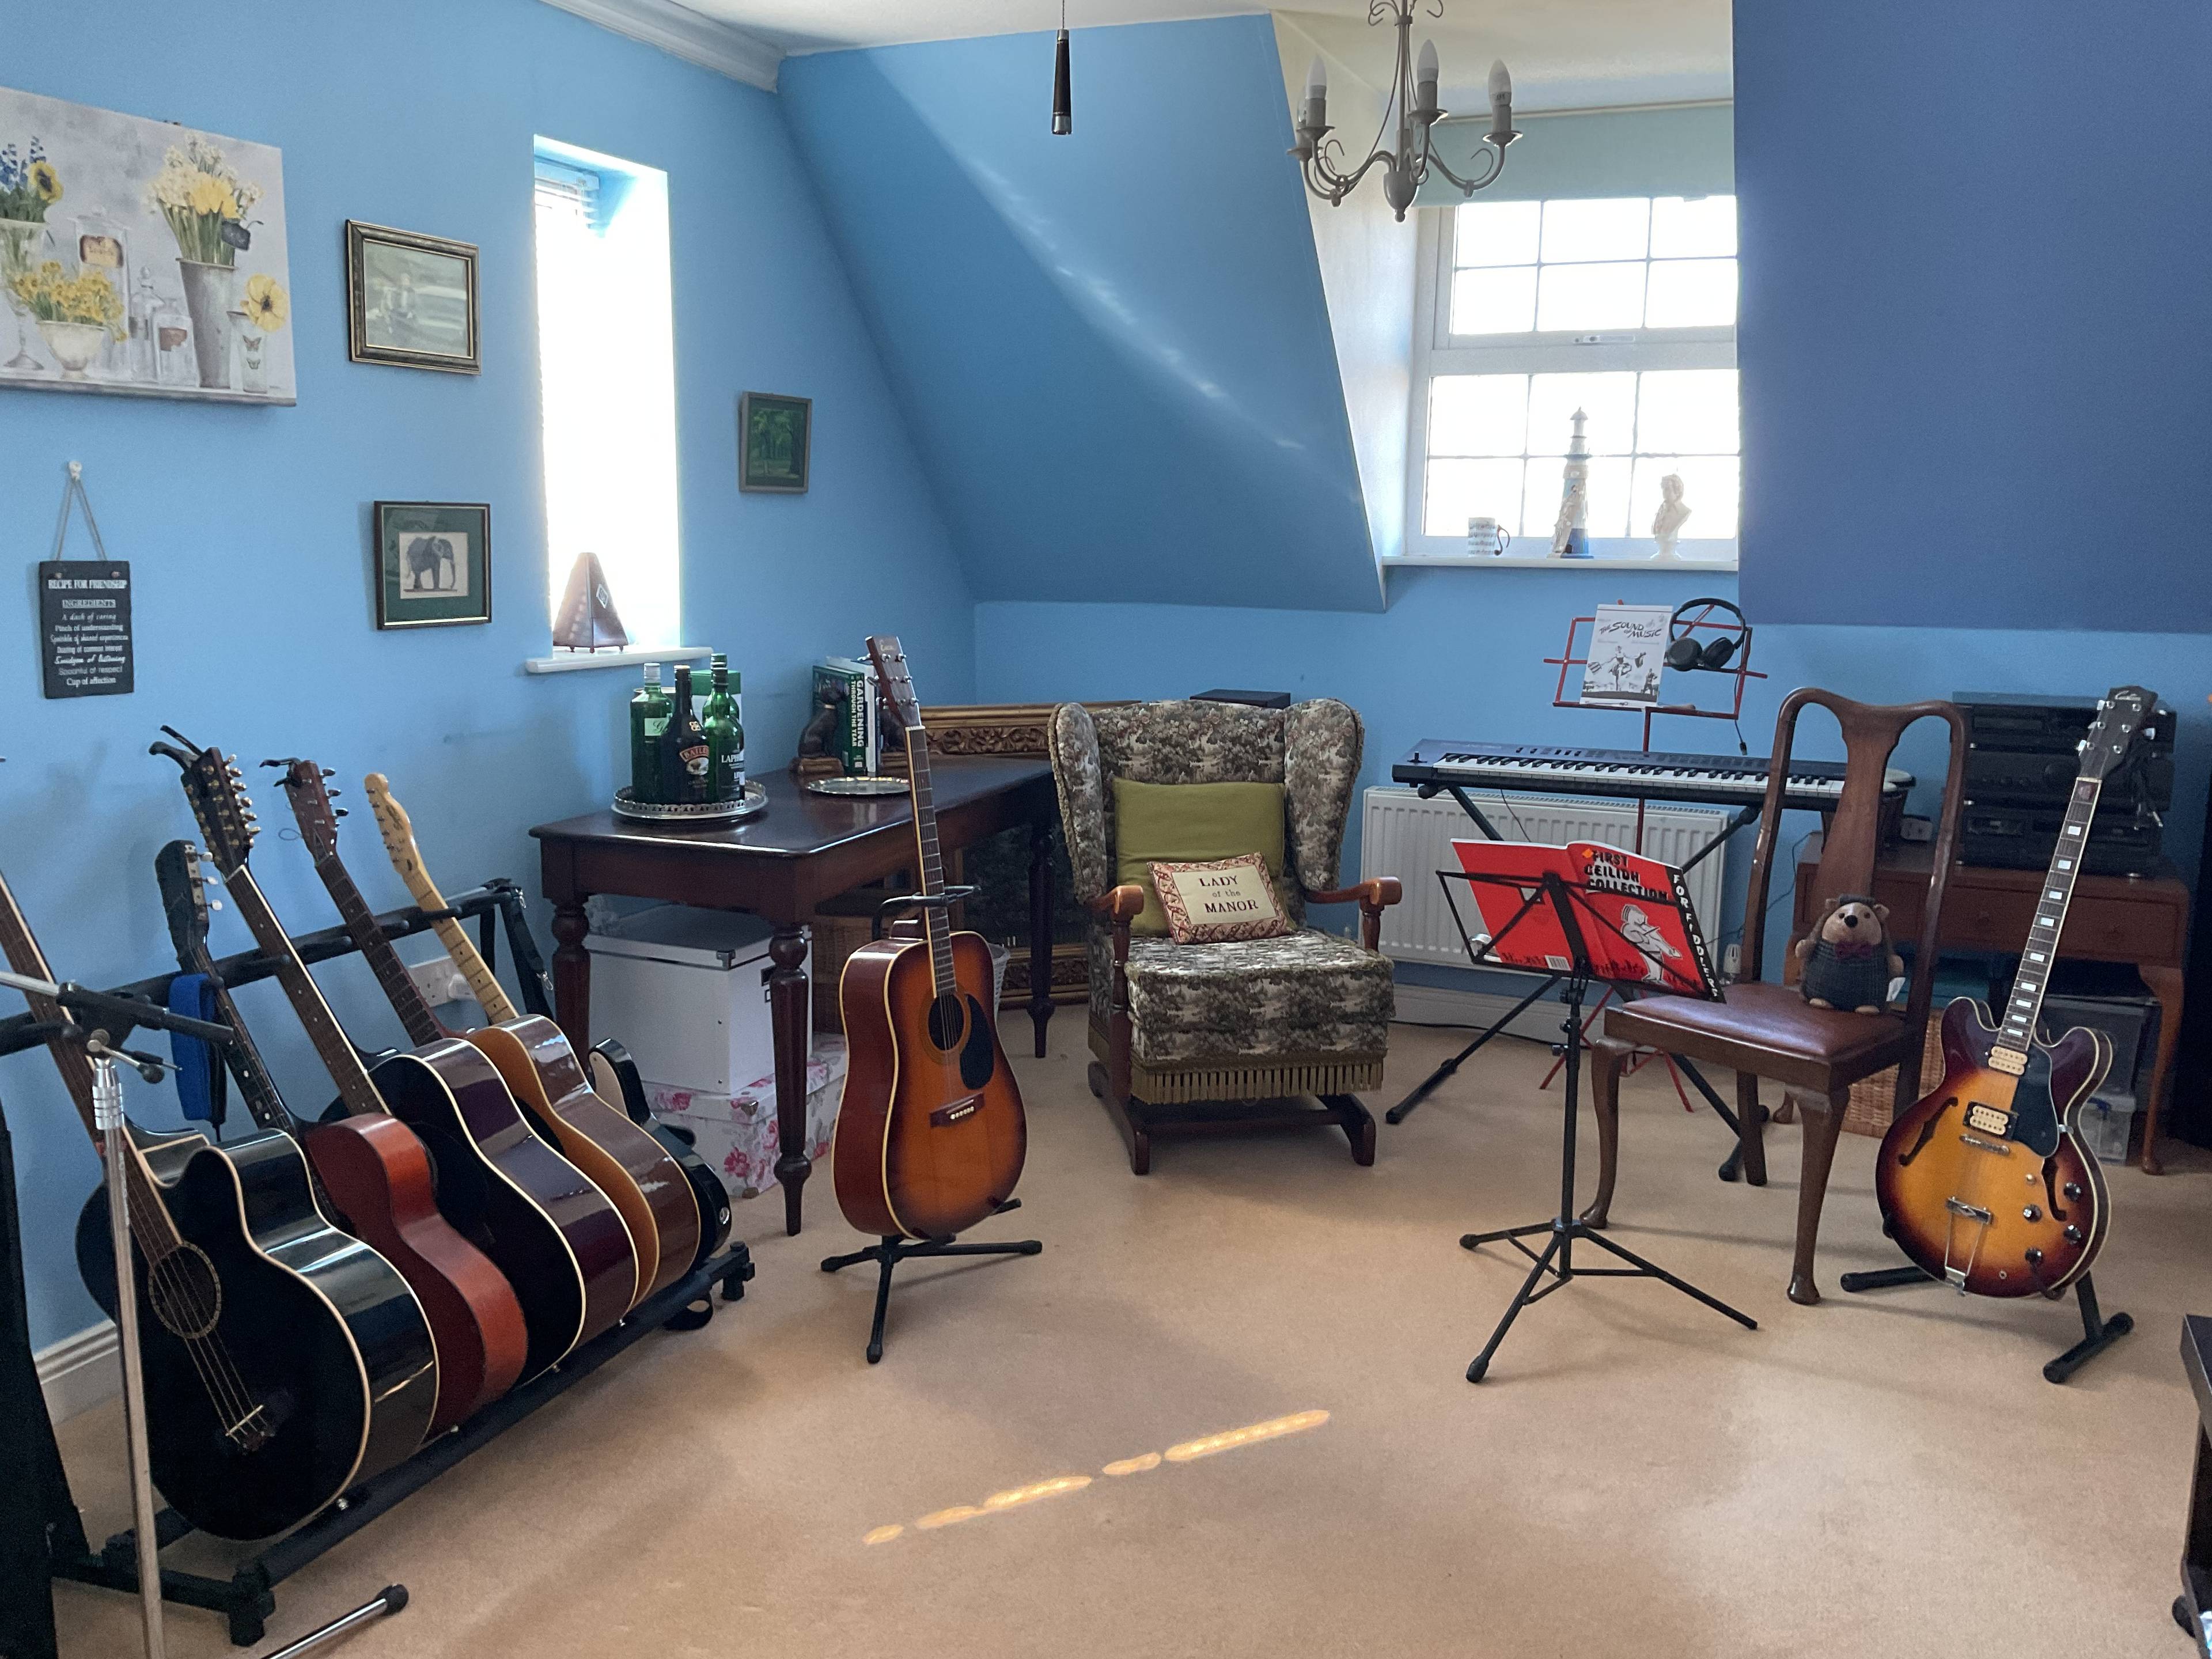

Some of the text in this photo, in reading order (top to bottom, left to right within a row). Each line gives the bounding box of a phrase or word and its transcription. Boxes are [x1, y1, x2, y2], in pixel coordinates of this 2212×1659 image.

[48, 579, 72, 589] RECIPE
[74, 579, 88, 589] FOR
[62, 599, 116, 608] INGREDIENTS
[87, 612, 94, 623] of
[1599, 622, 1645, 634] THE SOUND
[87, 654, 97, 663] of
[67, 677, 81, 688] Cup
[683, 748, 709, 759] BAILE
[1593, 851, 1628, 868] FIRST
[1584, 864, 1640, 884] CEILIDH
[1198, 876, 1238, 887] LADY
[1225, 889, 1241, 897] the
[1588, 878, 1668, 900] COLLECTION
[1205, 899, 1259, 914] MANOR
[1673, 874, 1718, 997] FOR FIDDLERS
